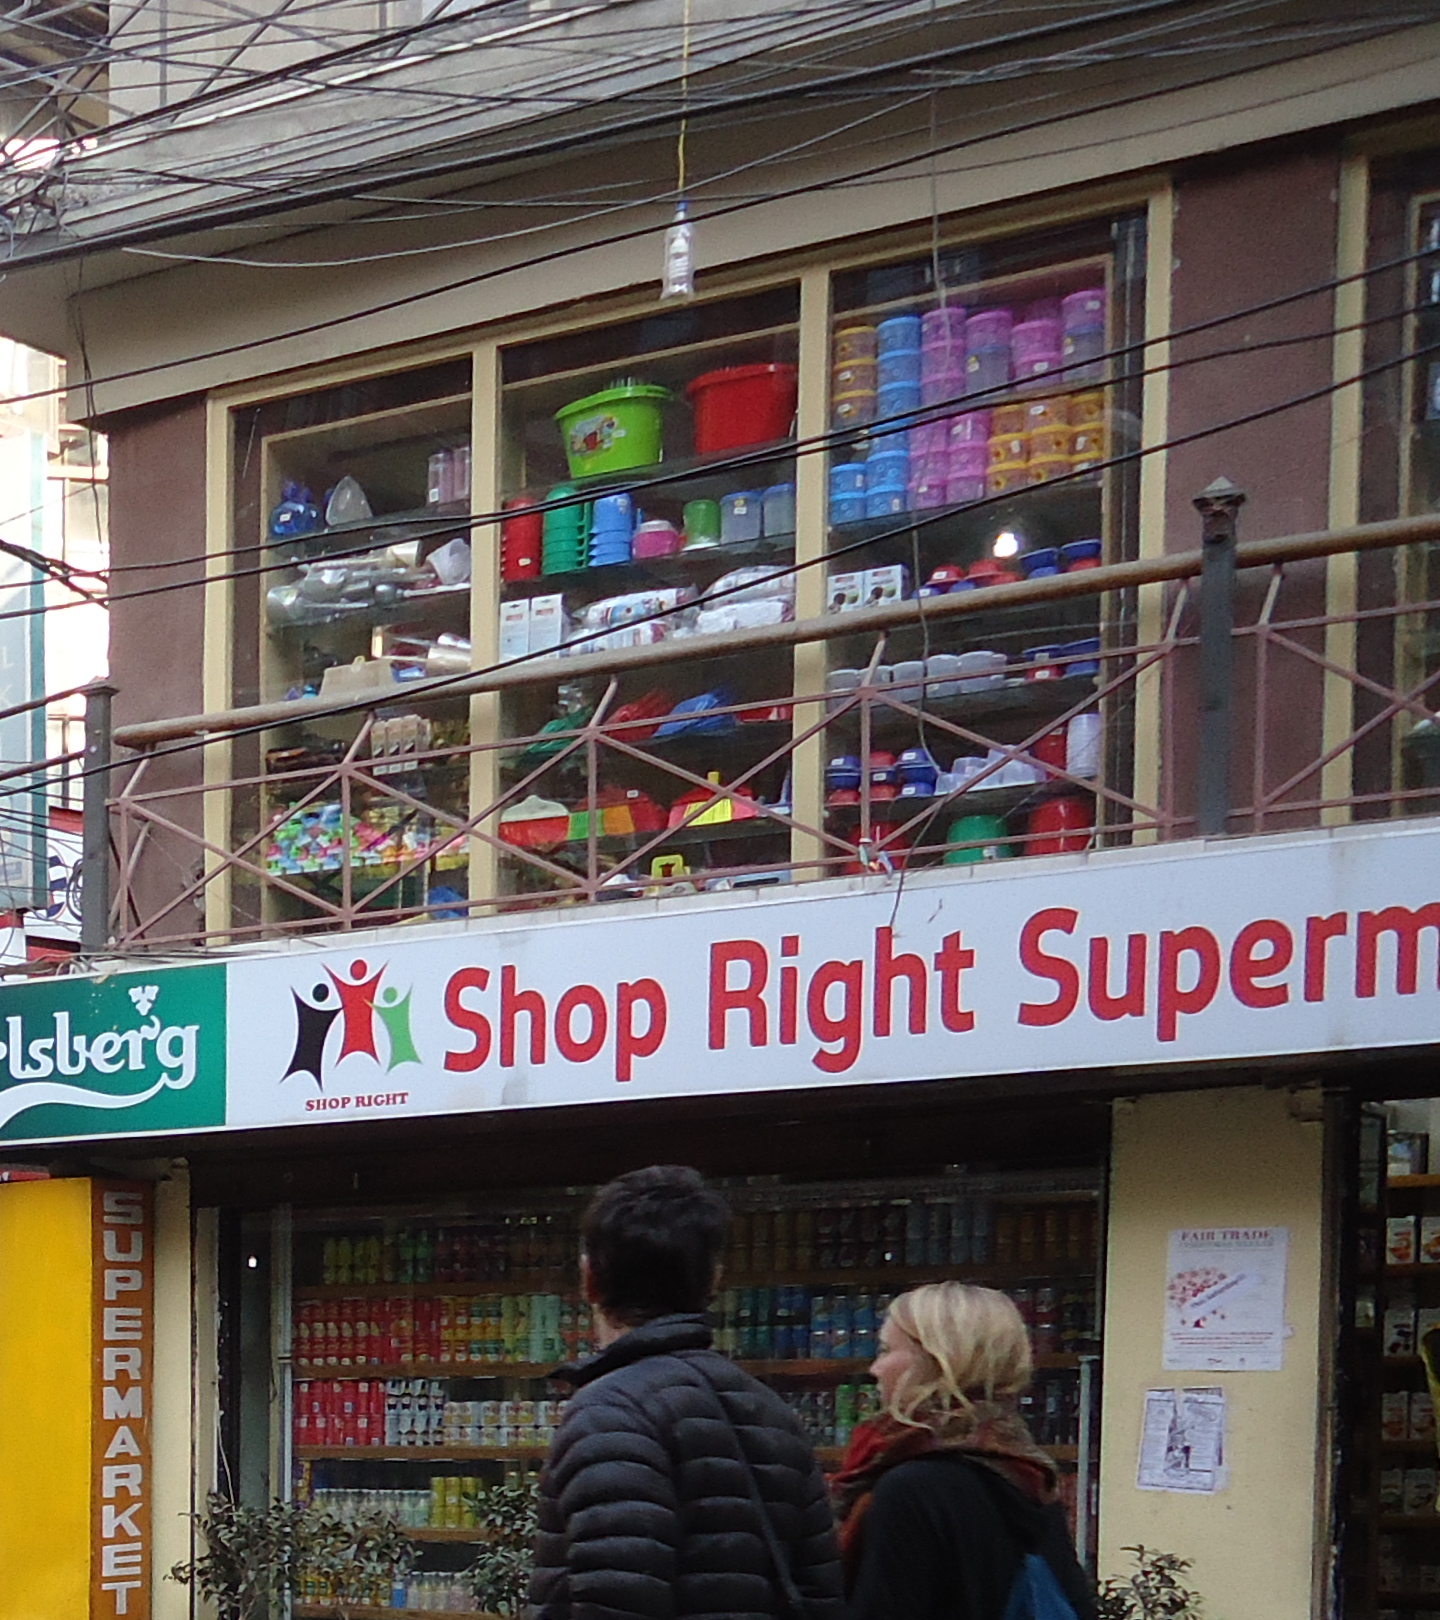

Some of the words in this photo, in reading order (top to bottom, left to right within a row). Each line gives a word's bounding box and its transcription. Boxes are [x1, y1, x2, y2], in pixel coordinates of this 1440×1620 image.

[444, 963, 667, 1083] Shop
[708, 924, 974, 1075] Right
[306, 1094, 351, 1112] SHOP
[355, 1092, 409, 1109] RIGHT
[100, 1192, 143, 1615] SUPERMARKET
